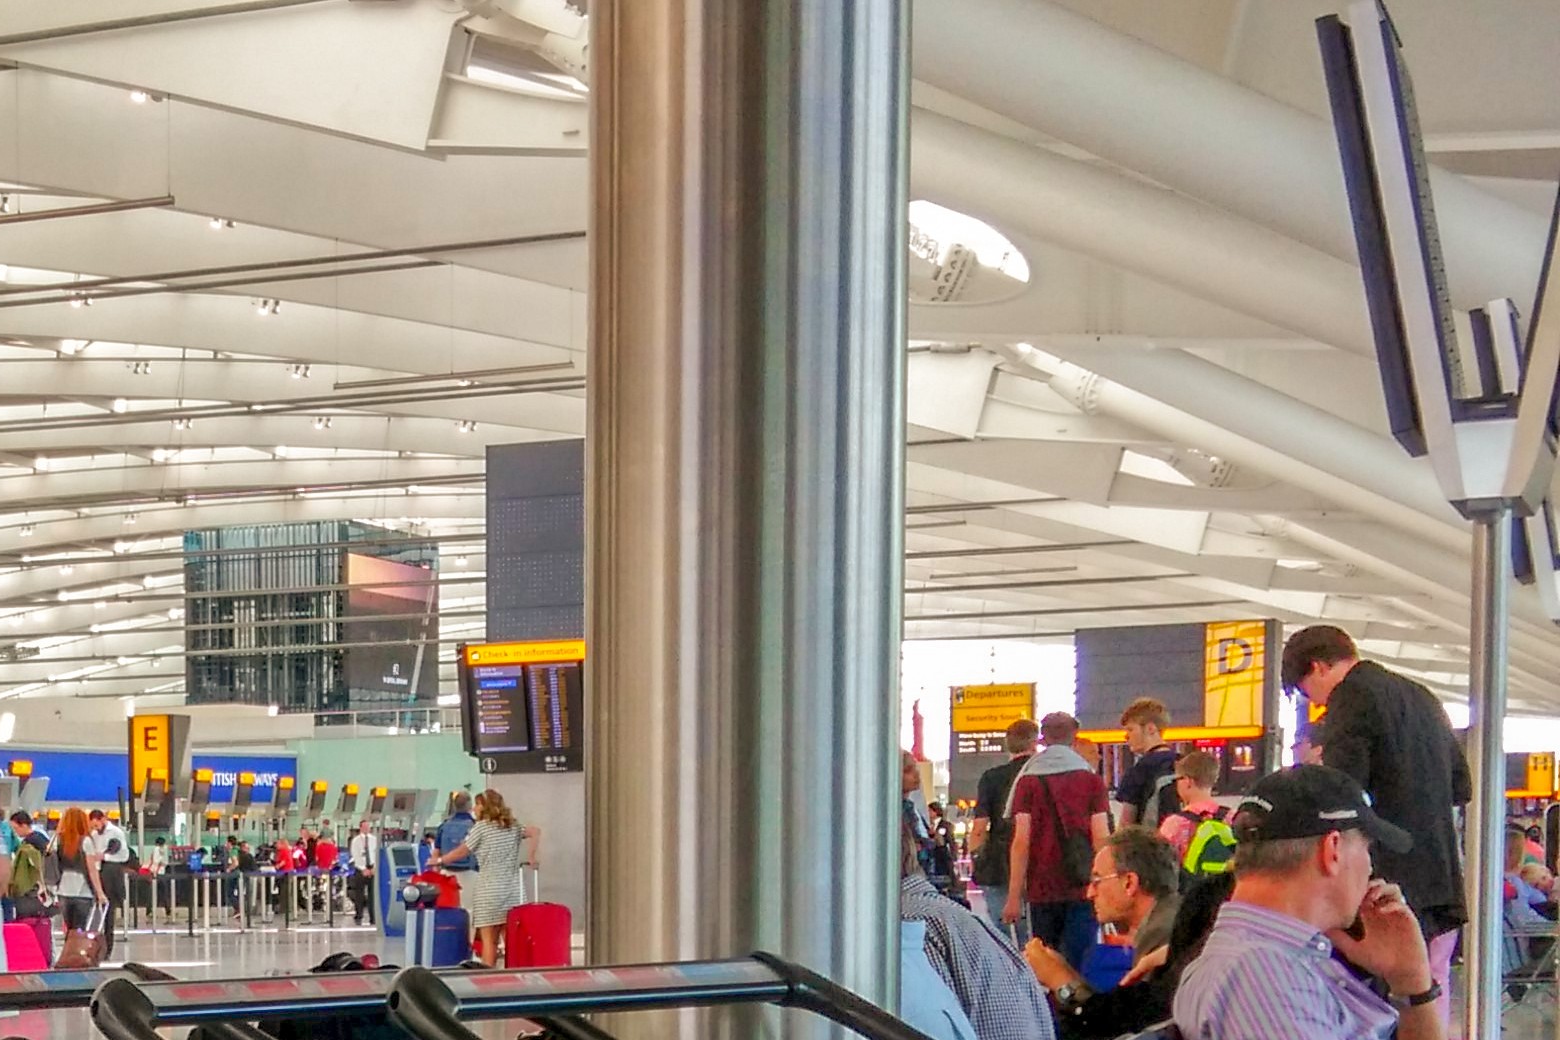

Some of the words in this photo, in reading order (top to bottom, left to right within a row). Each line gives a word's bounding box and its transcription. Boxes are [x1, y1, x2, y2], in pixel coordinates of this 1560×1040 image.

[1217, 637, 1253, 675] D
[966, 690, 1024, 700] Departures
[143, 726, 159, 751] E
[212, 773, 238, 787] ITISH
[252, 773, 279, 787] WAYS
